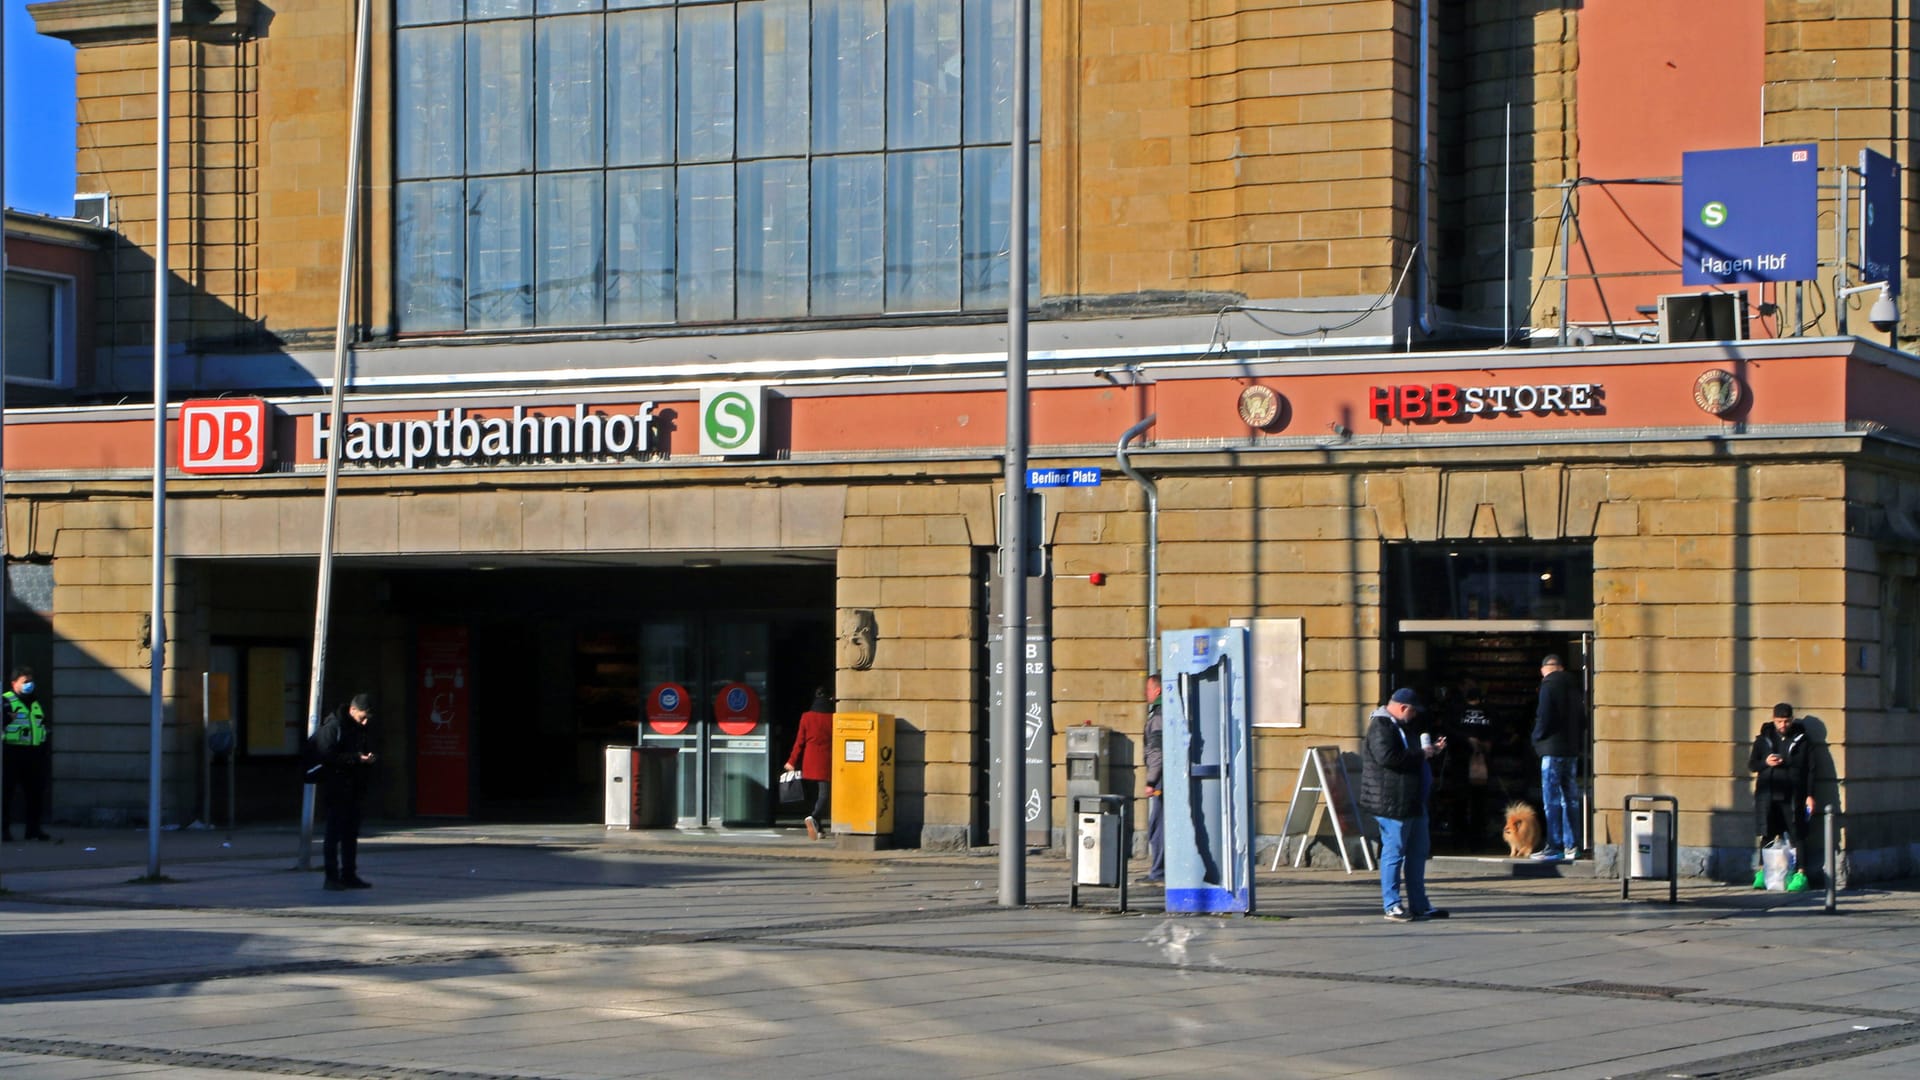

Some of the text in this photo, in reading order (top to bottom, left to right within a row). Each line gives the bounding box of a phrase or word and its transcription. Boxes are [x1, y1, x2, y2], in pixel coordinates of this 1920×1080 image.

[1704, 204, 1723, 225] S
[1701, 254, 1787, 275] Hagen Hbf
[1369, 384, 1593, 419] HBB STORE
[714, 397, 746, 443] S
[189, 411, 252, 461] DB
[313, 402, 654, 469] Hauptbahnhof
[1031, 470, 1097, 484] Berliner Platz
[995, 662, 1044, 674] SRE
